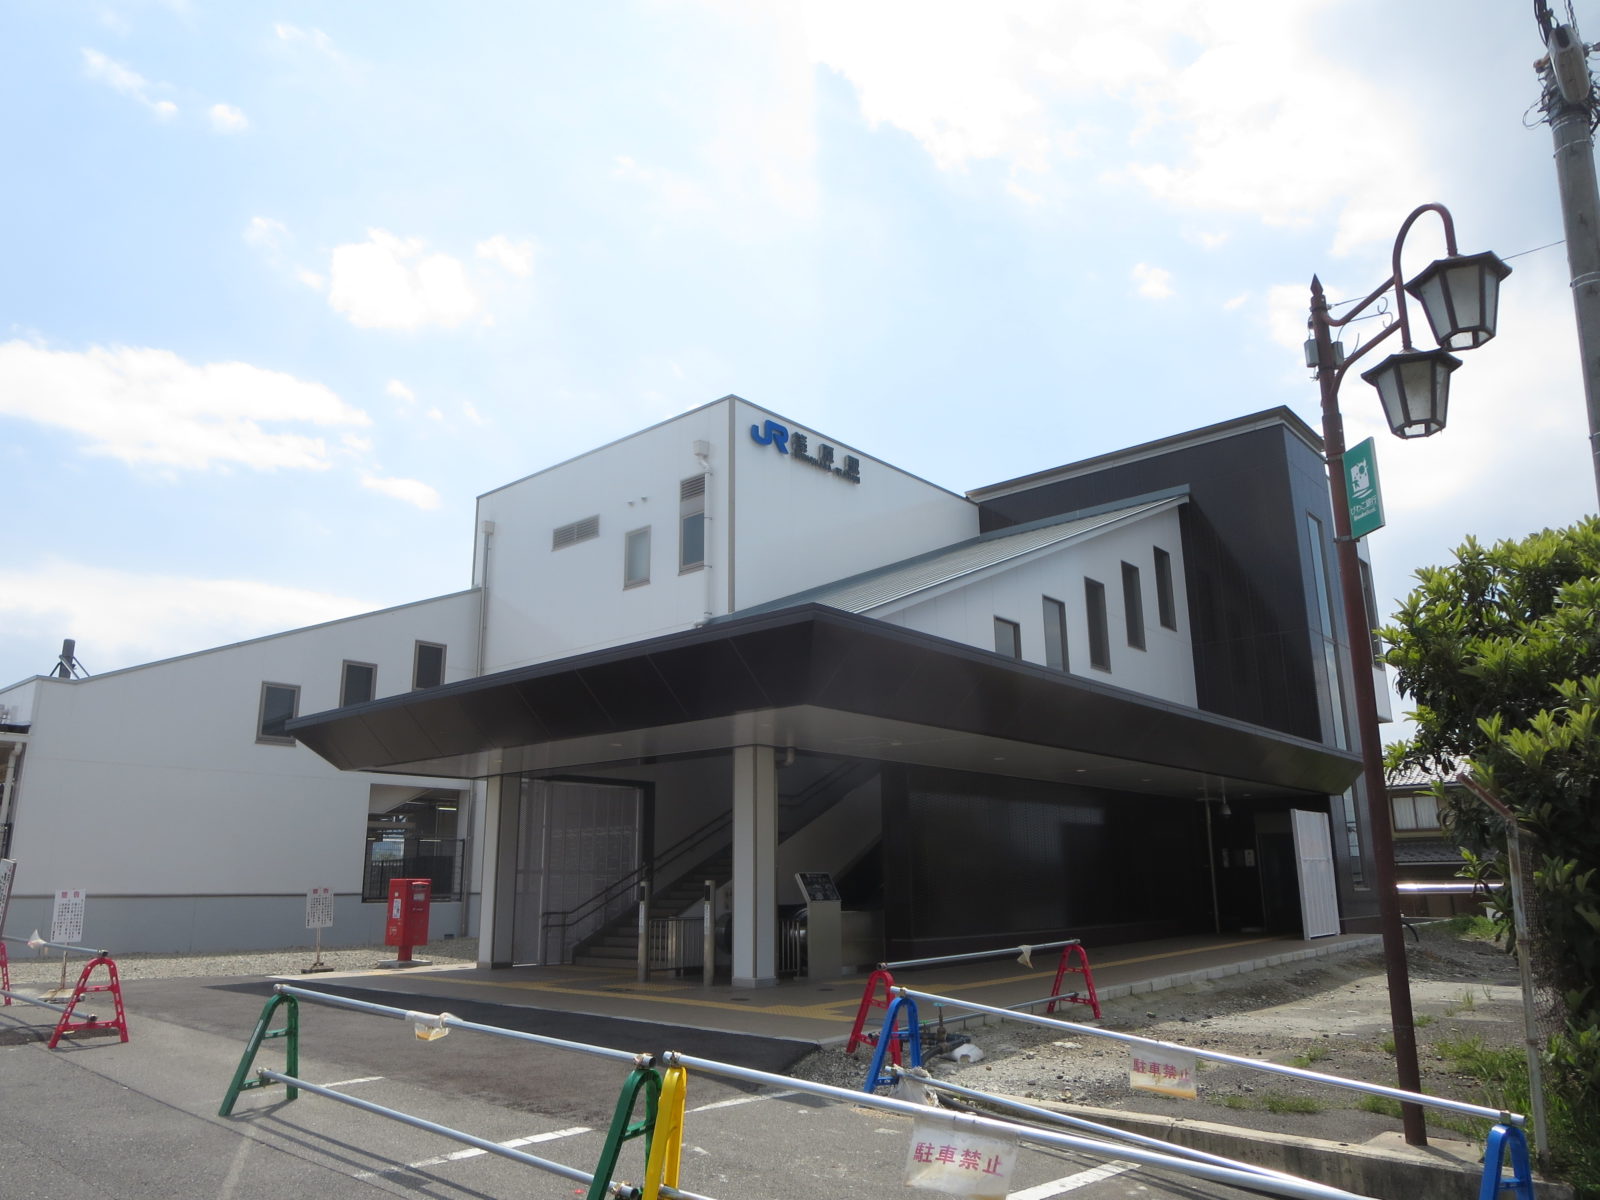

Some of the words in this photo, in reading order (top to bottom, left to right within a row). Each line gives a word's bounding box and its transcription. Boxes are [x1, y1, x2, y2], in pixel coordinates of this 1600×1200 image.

[751, 420, 789, 454] JR
[1133, 1058, 1192, 1082] 駐車禁止
[913, 1142, 1005, 1177] 駐車禁止
